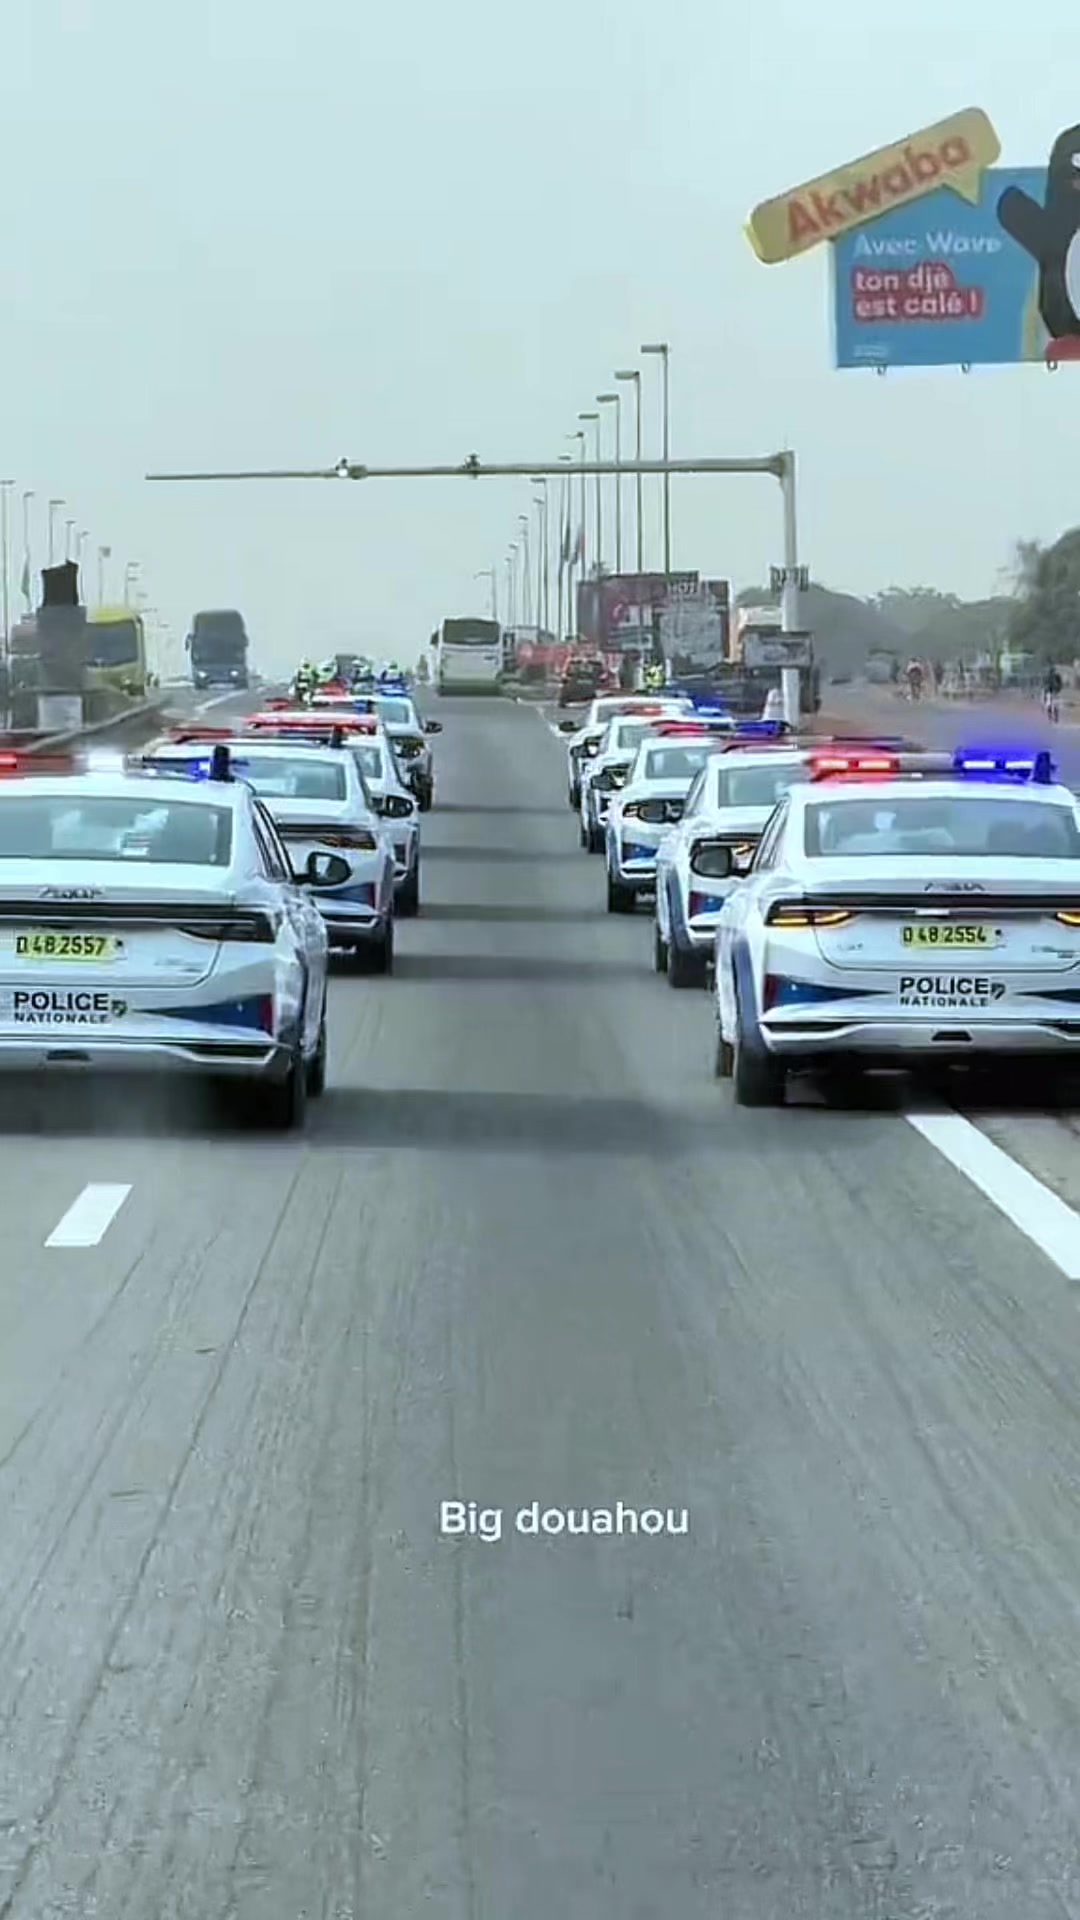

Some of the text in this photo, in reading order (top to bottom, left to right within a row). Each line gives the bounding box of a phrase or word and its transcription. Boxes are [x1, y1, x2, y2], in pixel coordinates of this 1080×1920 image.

[788, 136, 969, 242] Akwaba
[855, 231, 1002, 256] Avec Wave
[856, 271, 899, 291] ton
[856, 297, 897, 317] est
[900, 977, 989, 994] POLICE
[14, 991, 109, 1011] POLICE
[900, 996, 989, 1008] NATIONALE
[14, 1012, 109, 1024] NATIONALE
